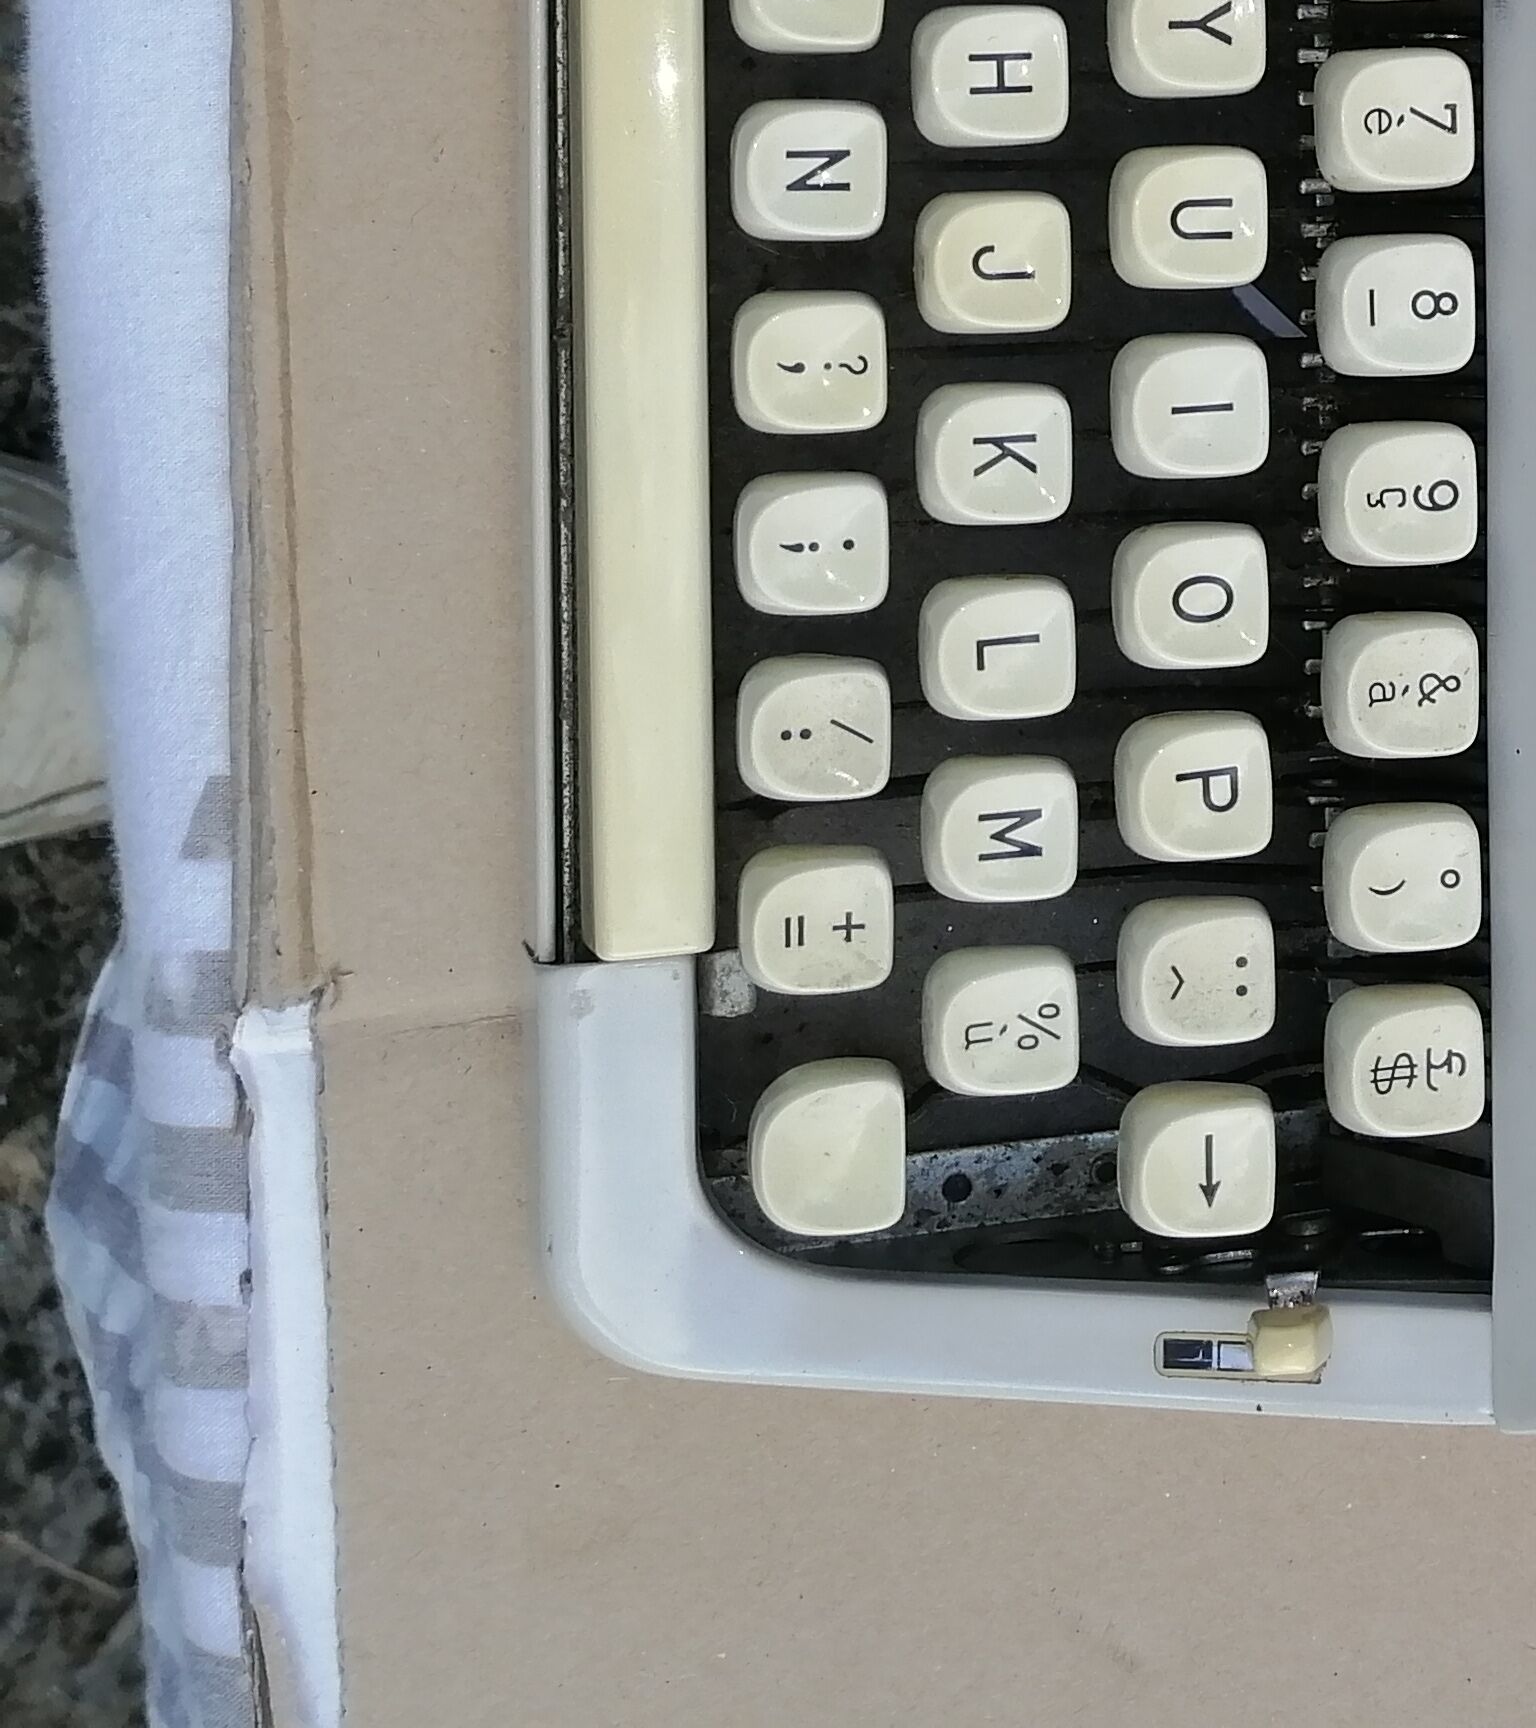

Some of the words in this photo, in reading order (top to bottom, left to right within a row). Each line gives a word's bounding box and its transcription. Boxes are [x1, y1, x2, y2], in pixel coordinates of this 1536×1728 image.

[1167, 0, 1233, 46] Y
[968, 52, 1034, 95] H
[1363, 107, 1405, 136] è
[1409, 103, 1458, 135] 7
[785, 149, 851, 192] N
[1169, 197, 1233, 241] U
[971, 244, 1036, 281] J
[1411, 289, 1459, 320] 8
[823, 354, 869, 376] ?
[1170, 402, 1234, 416] I
[972, 433, 1038, 477] K
[1366, 487, 1407, 509] ç
[1412, 479, 1460, 512] 9
[1171, 575, 1234, 624] O
[976, 633, 1041, 672] L
[1368, 681, 1410, 708] à
[1417, 672, 1462, 708] &
[780, 728, 812, 742] :
[829, 719, 874, 744] /
[1175, 766, 1239, 813] P
[977, 808, 1043, 862] M
[1368, 879, 1406, 896] )
[784, 915, 805, 949] =
[832, 911, 866, 944] +
[964, 1021, 1008, 1051] ù
[1016, 1002, 1062, 1051] %
[1369, 1052, 1418, 1096] $
[1426, 1047, 1467, 1092] £
